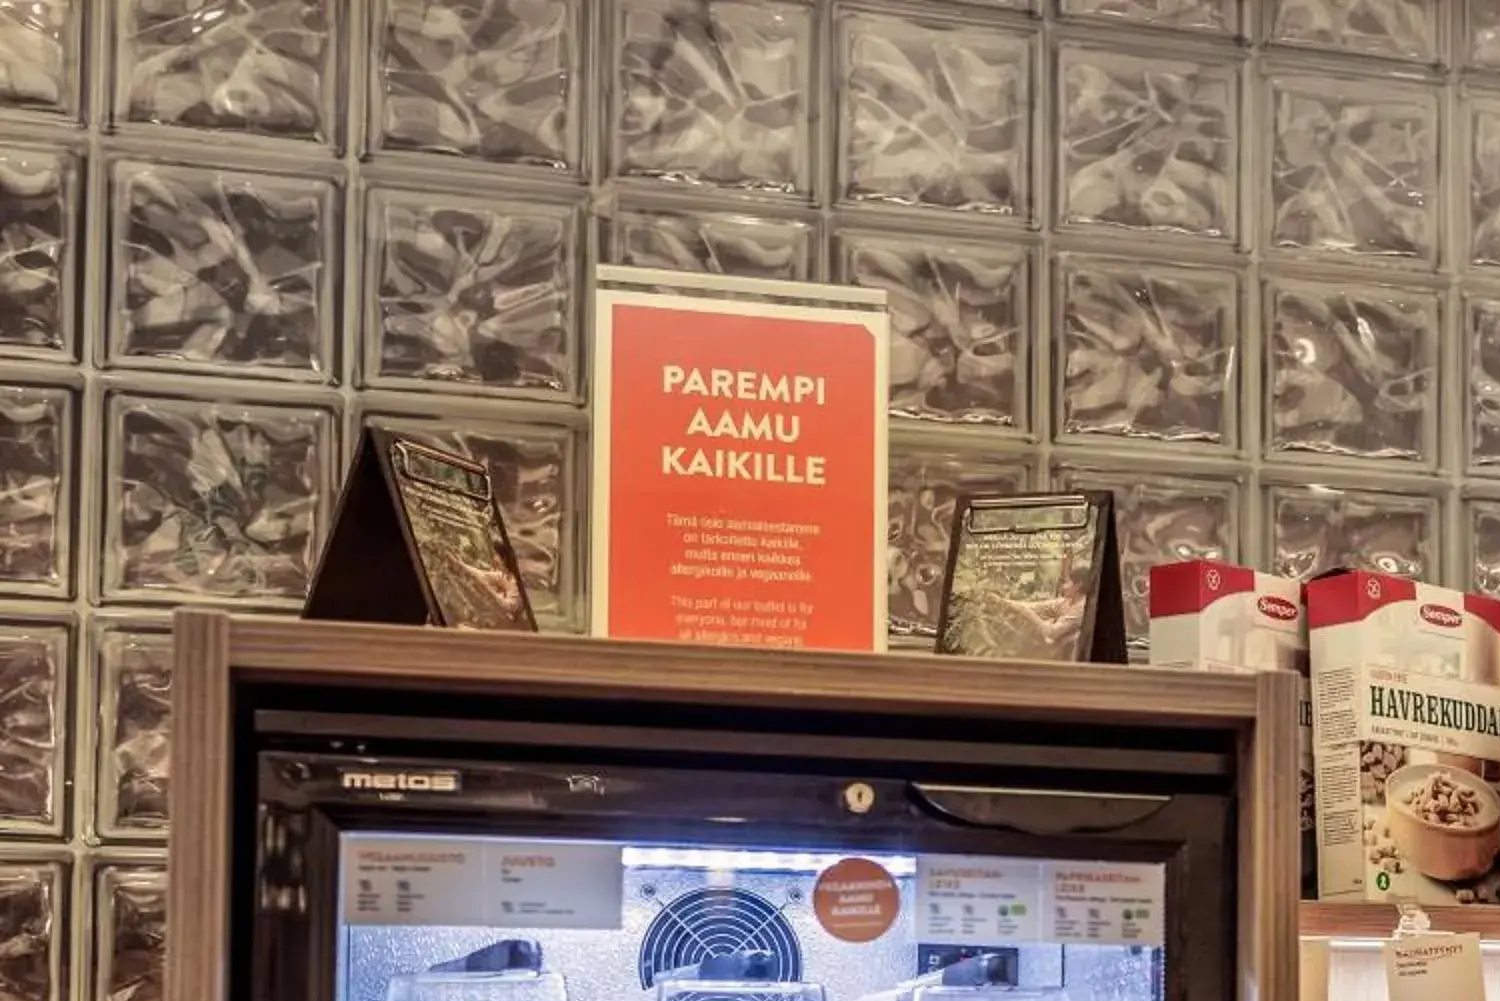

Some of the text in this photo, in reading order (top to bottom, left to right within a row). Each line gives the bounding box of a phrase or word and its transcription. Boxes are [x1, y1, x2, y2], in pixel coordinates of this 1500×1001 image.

[663, 365, 825, 404] PAREMPI
[687, 407, 800, 442] AAMU
[662, 446, 825, 485] KAIKILLE
[1259, 598, 1297, 619] Semper
[1422, 606, 1463, 628] Semper
[342, 771, 459, 791] metos
